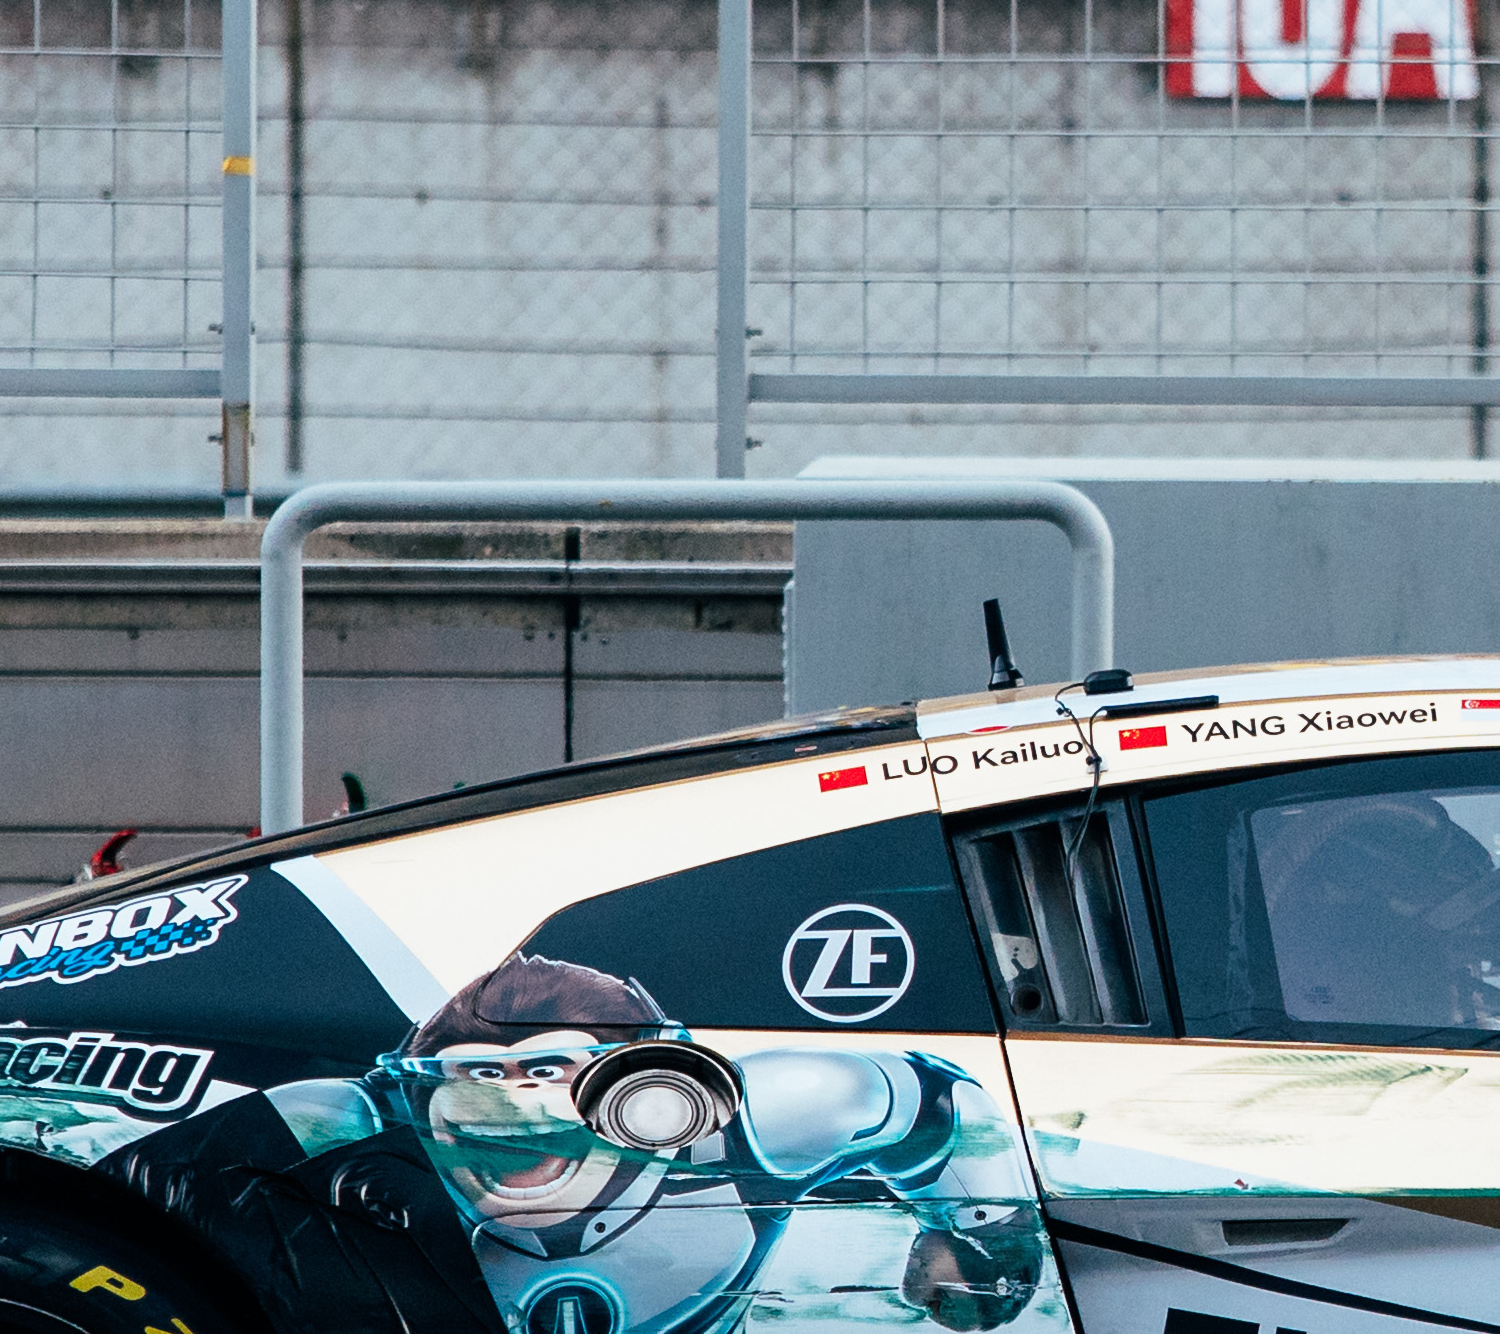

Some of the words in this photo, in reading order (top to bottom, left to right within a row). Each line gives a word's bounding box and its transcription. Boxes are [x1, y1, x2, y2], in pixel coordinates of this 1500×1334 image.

[1181, 715, 1286, 744] YANG
[1298, 703, 1438, 734] Xiaowei
[882, 753, 960, 781] LUO
[972, 740, 1084, 770] Kailuo
[794, 926, 905, 1000] ZF
